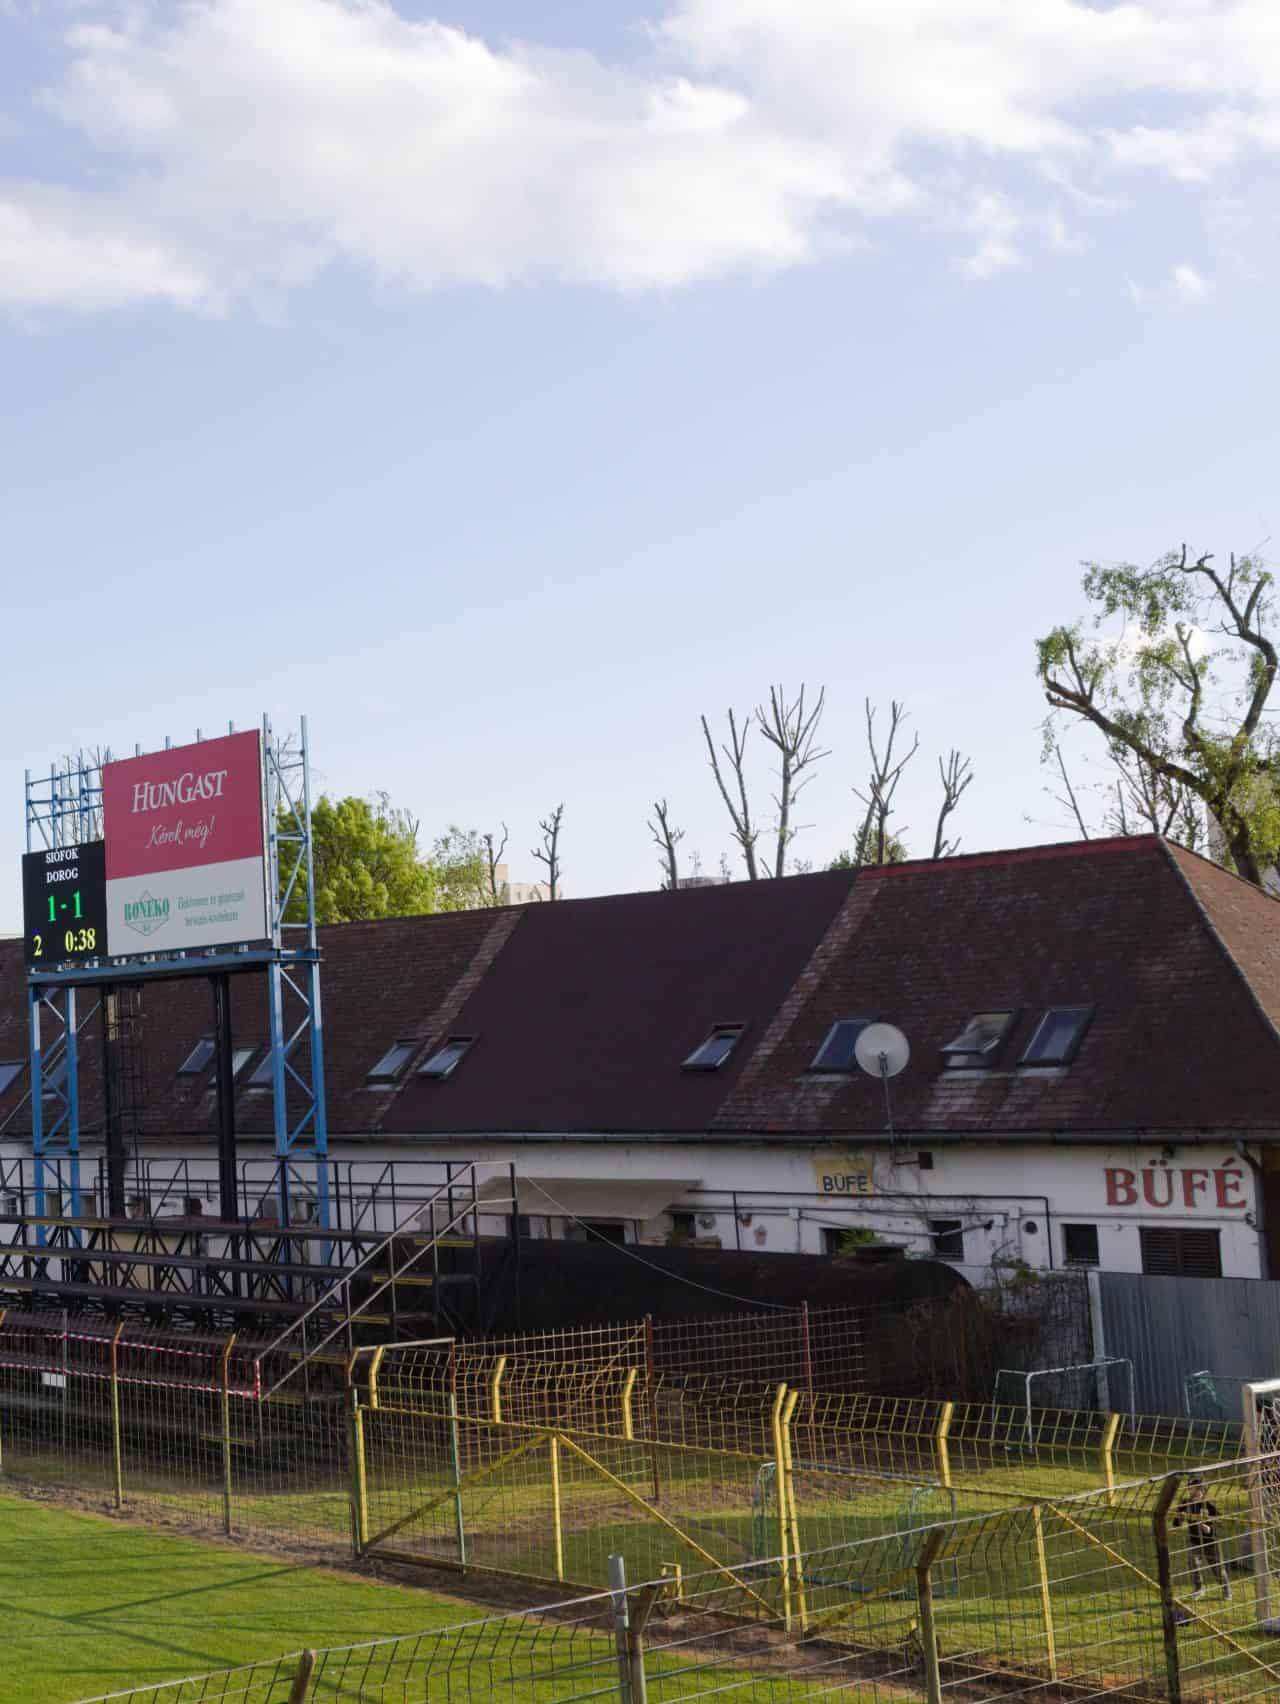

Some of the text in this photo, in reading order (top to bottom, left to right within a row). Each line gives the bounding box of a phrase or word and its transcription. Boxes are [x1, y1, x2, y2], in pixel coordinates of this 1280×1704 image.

[46, 867, 79, 884] DOROG
[33, 928, 96, 956] 2 0:38
[1104, 1156, 1247, 1209] BÜFÉ
